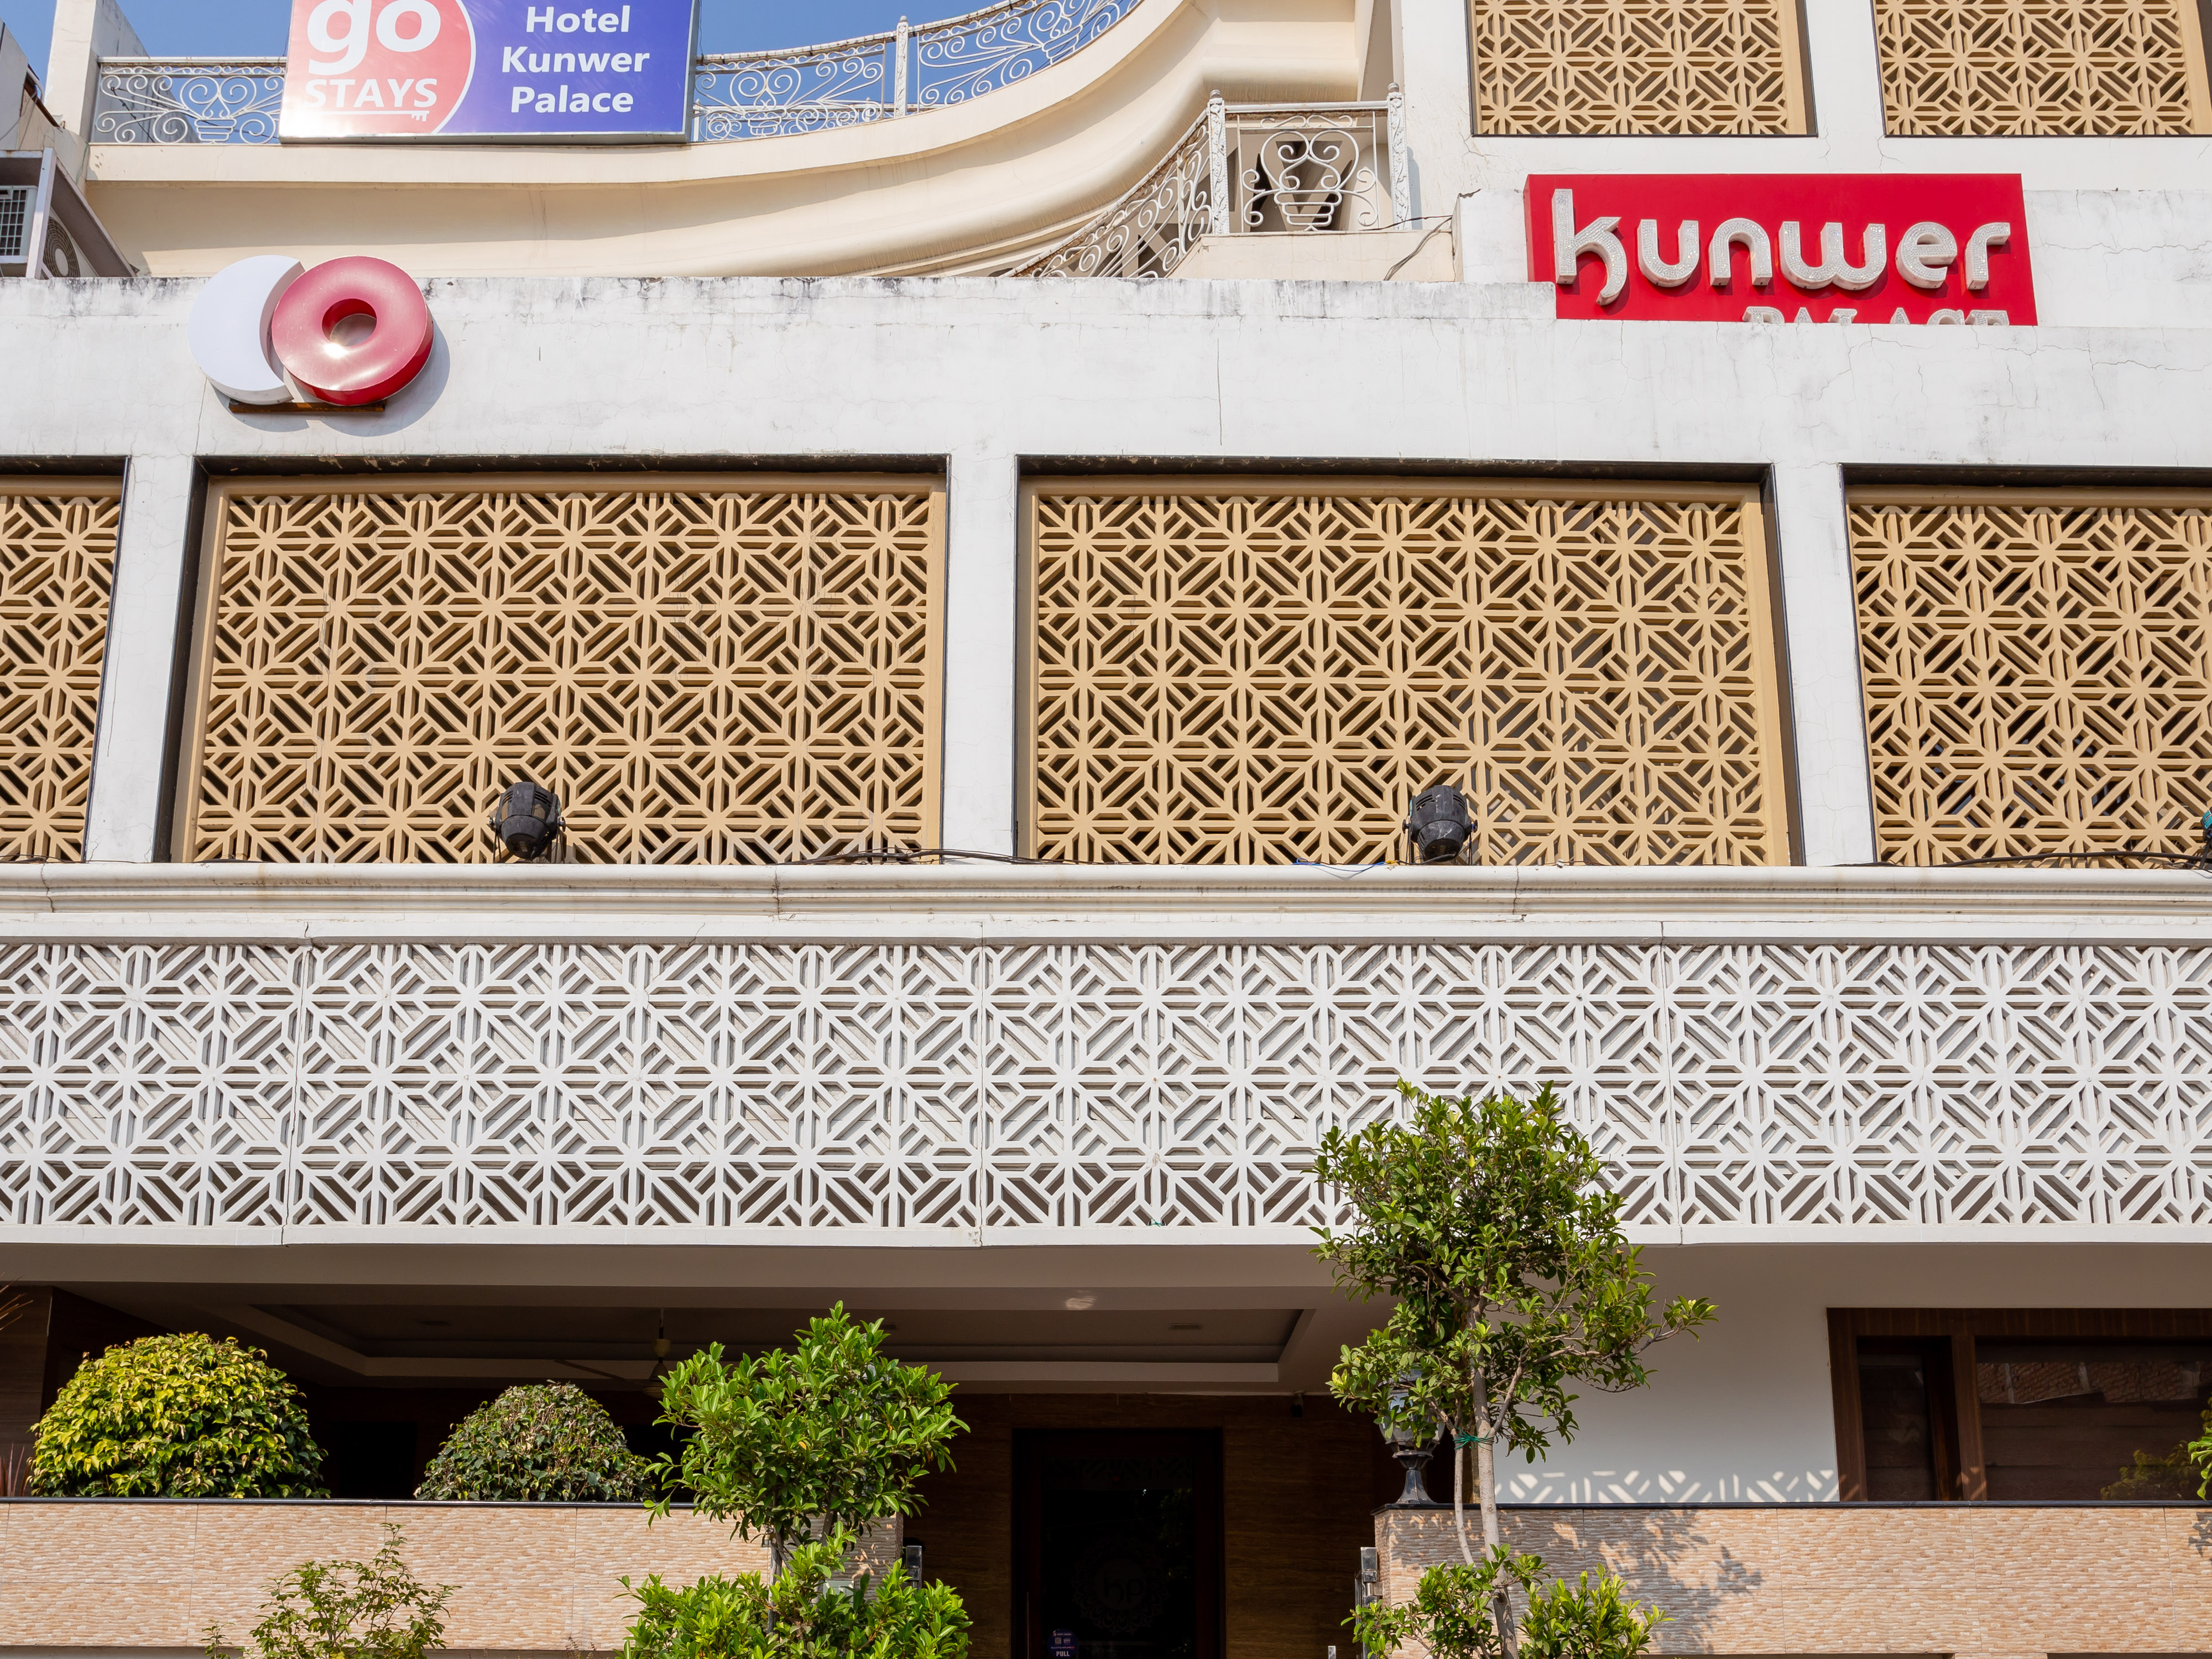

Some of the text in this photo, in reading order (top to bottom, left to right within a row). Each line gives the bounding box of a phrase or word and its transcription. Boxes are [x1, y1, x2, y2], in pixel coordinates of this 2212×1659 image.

[526, 5, 630, 33] Hotel
[307, 0, 441, 75] go
[502, 46, 650, 73] Kunwer
[302, 79, 437, 109] STAYS
[511, 85, 634, 113] Palace
